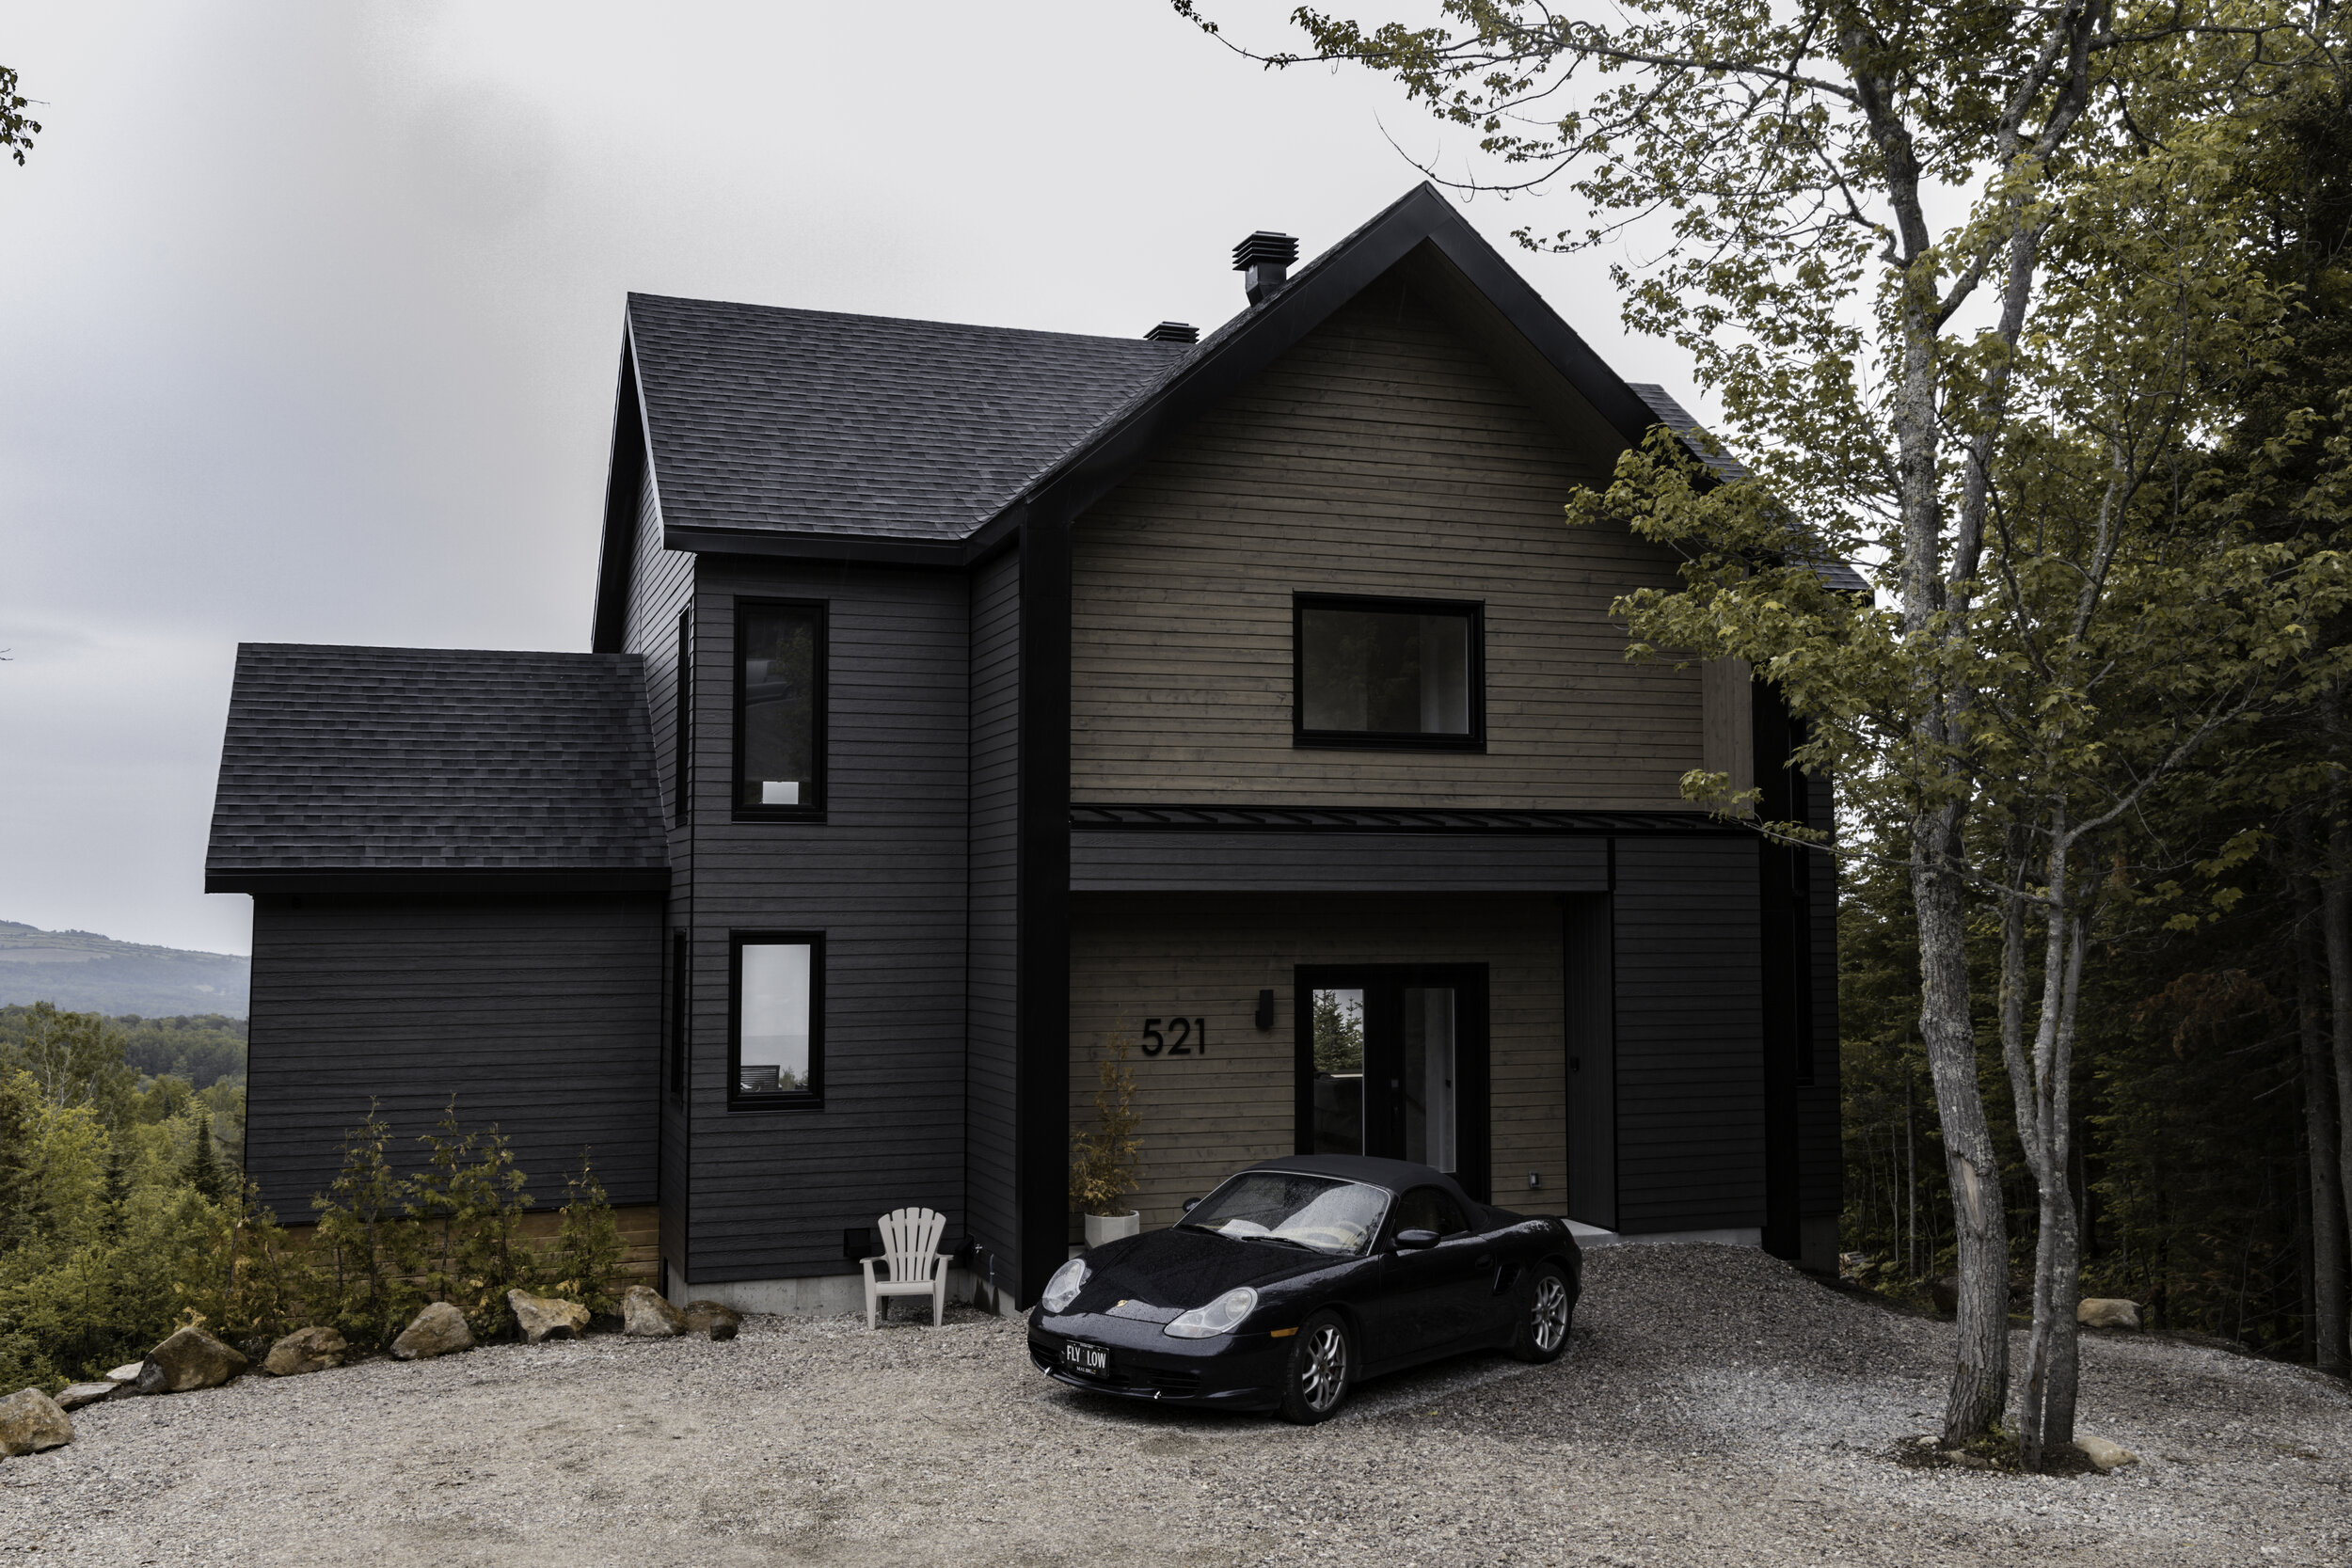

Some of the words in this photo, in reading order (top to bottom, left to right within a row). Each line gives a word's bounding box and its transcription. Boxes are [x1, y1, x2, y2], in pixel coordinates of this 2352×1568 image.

[1141, 1017, 1205, 1056] 521
[1067, 1345, 1081, 1363] FLY
[1087, 1350, 1106, 1369] LOW
